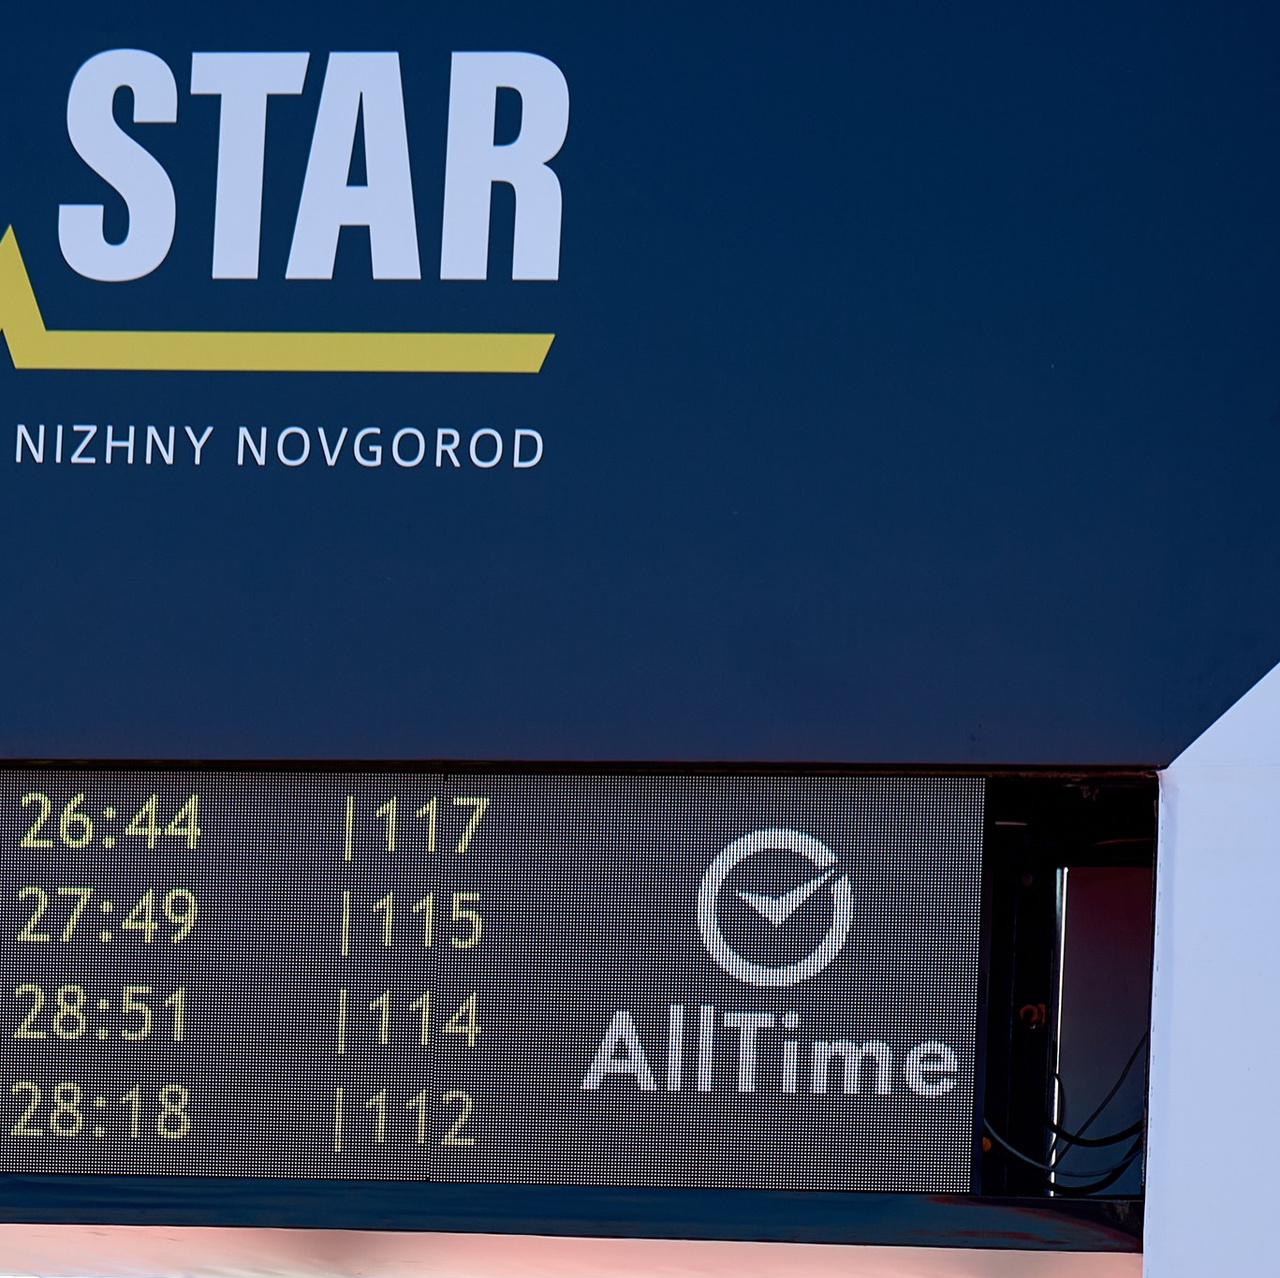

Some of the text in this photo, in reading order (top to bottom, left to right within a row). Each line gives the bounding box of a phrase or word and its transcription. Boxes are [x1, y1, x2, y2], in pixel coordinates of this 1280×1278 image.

[58, 48, 570, 282] STAR
[15, 424, 544, 468] NIZHNY NOVGOROD
[19, 792, 202, 851] 26:44
[16, 884, 199, 944] 27:49
[13, 982, 188, 1042] 28:51
[580, 1003, 959, 1095] AllTime
[9, 1078, 191, 1139] 28:18
